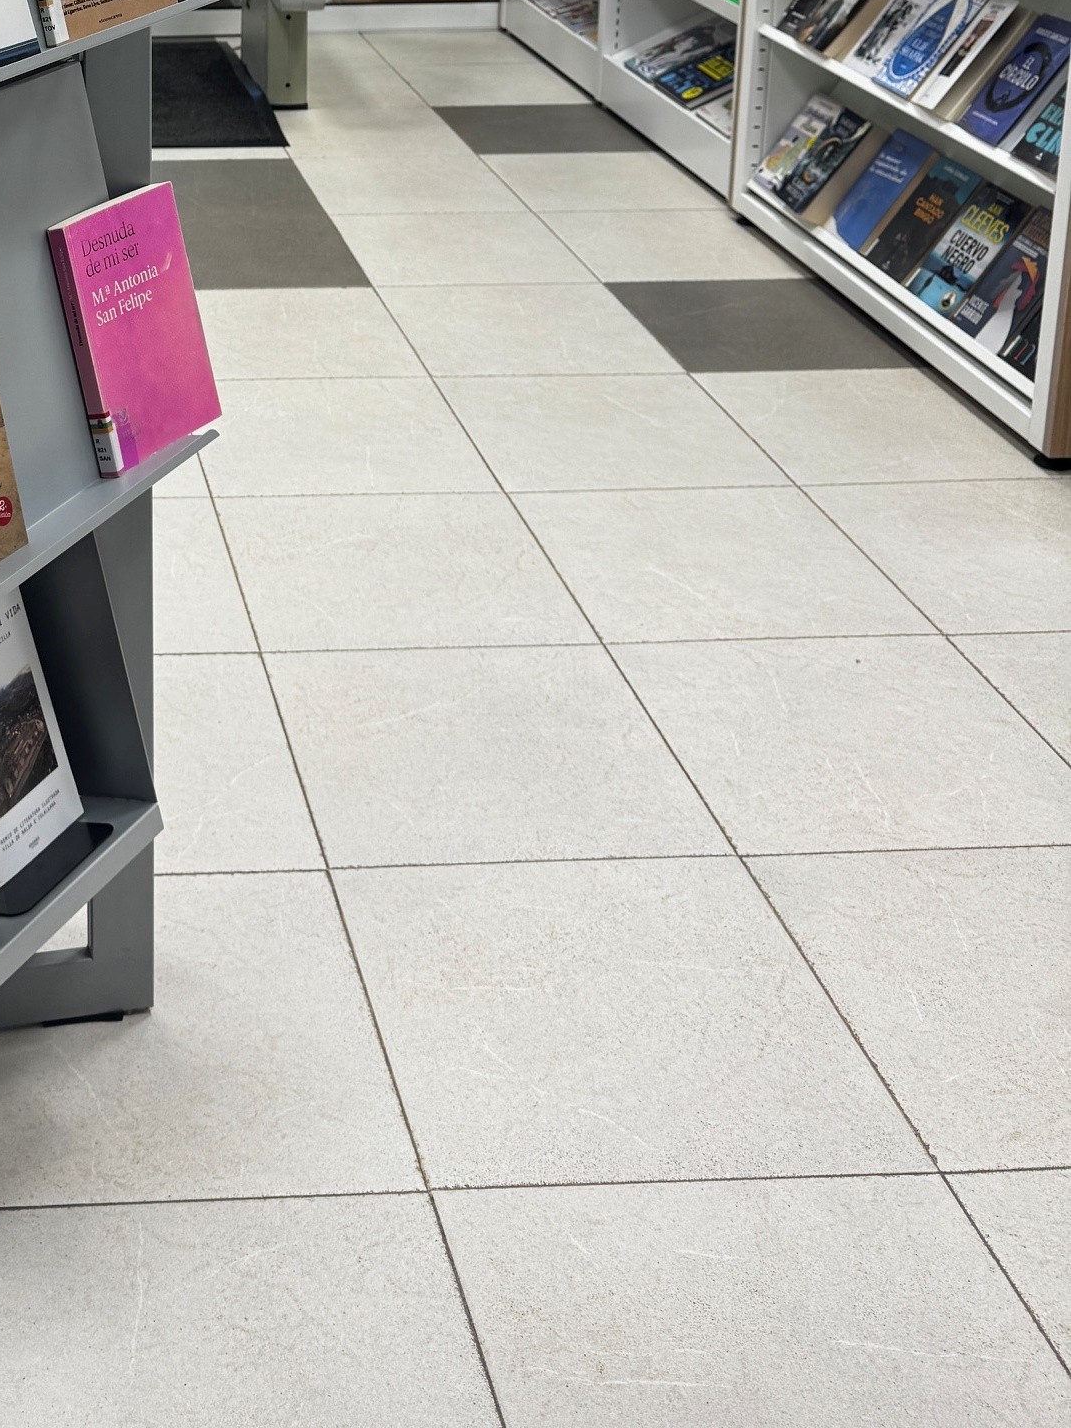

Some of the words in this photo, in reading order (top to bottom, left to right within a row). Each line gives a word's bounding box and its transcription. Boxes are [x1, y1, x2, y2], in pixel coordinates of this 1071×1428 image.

[81, 221, 136, 257] Desnuda
[961, 204, 1010, 245] CLEEVES
[85, 260, 101, 278] de
[103, 250, 120, 272] mi
[122, 241, 141, 262] ser
[941, 245, 977, 275] NEGRO
[950, 229, 989, 262] CUERVO
[113, 263, 159, 298] Antonia
[96, 304, 119, 327] San
[119, 287, 154, 316] Felipe
[5, 602, 22, 622] VIDA
